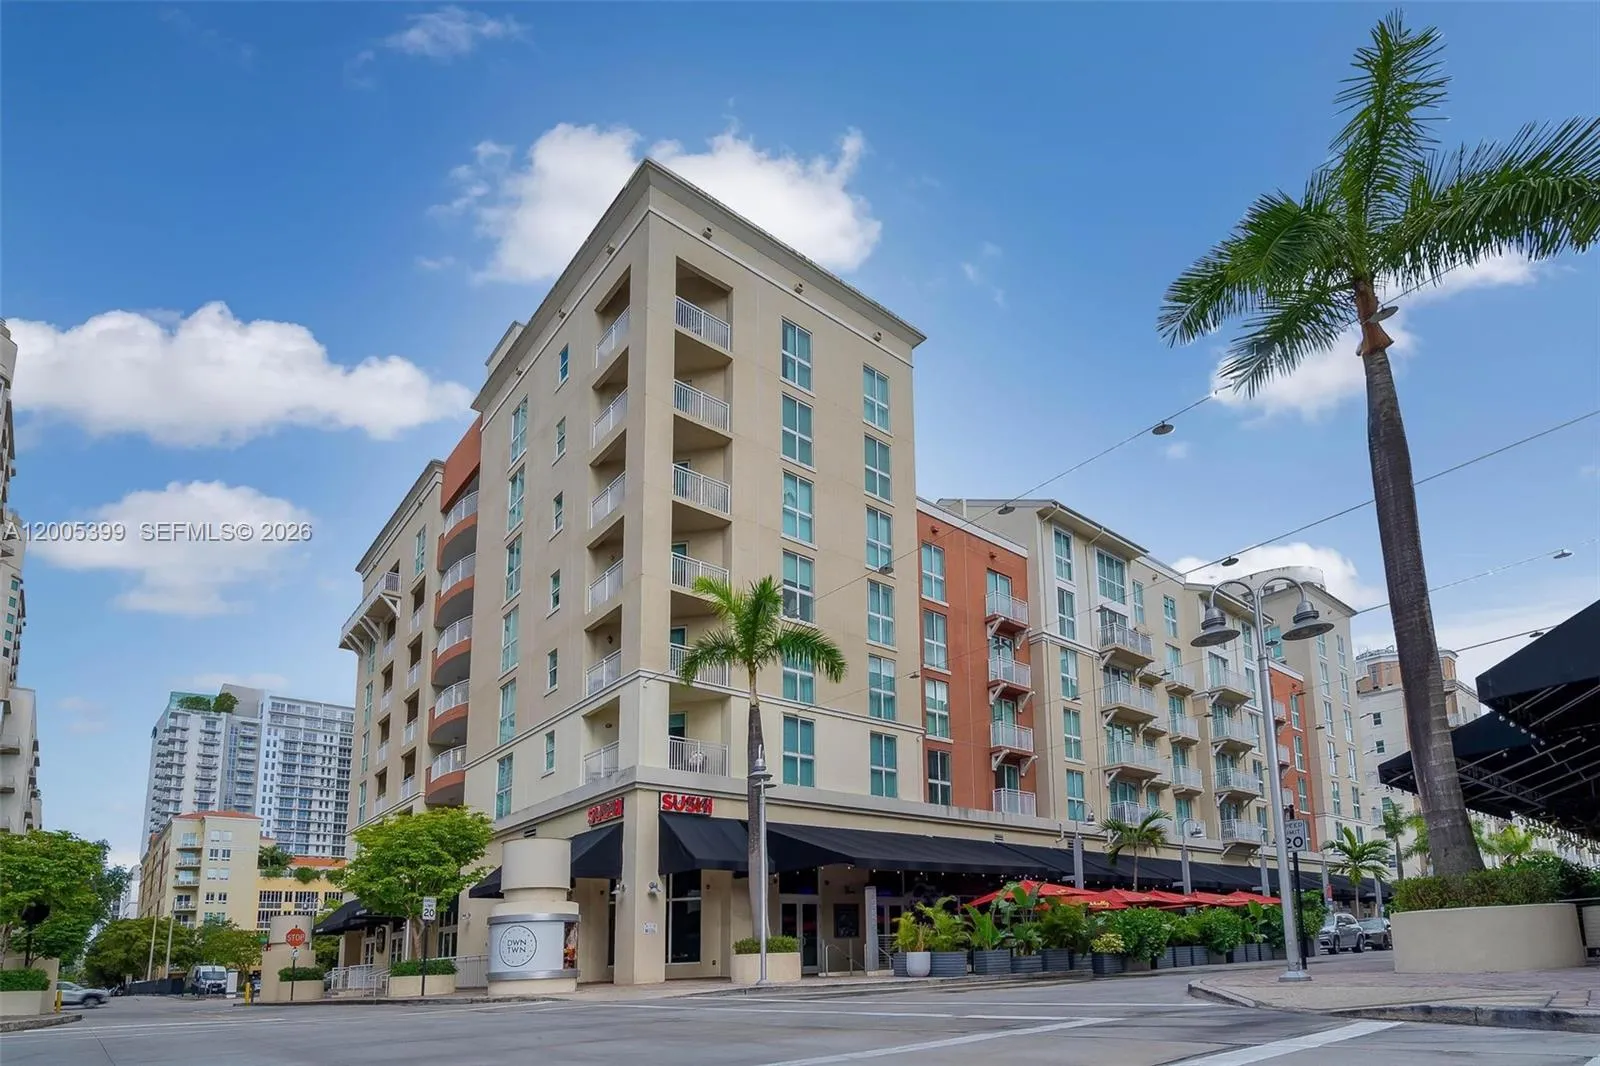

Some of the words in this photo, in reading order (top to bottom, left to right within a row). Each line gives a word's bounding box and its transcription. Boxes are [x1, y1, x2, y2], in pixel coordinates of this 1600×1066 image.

[661, 793, 713, 816] SUSHI
[423, 908, 435, 918] 20
[287, 933, 305, 942] STOP
[507, 939, 527, 947] DWN
[507, 946, 526, 954] TWN
